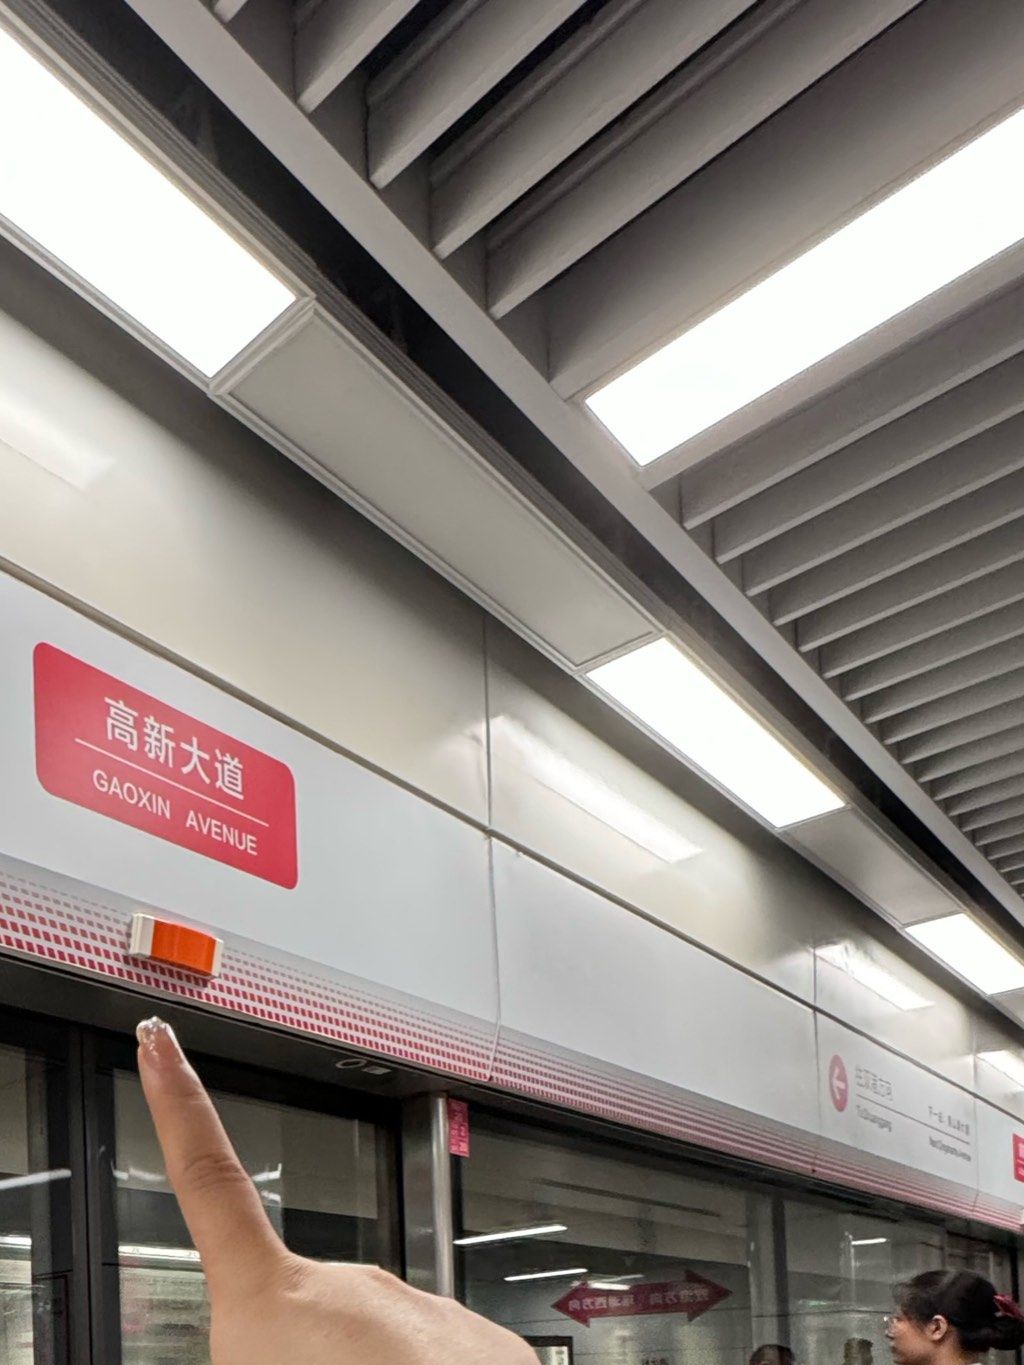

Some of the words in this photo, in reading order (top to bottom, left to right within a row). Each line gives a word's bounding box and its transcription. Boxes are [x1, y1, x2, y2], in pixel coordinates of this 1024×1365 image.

[104, 696, 245, 800] 高新大道
[92, 769, 172, 819] GAOXIN
[185, 810, 258, 856] AVENUE
